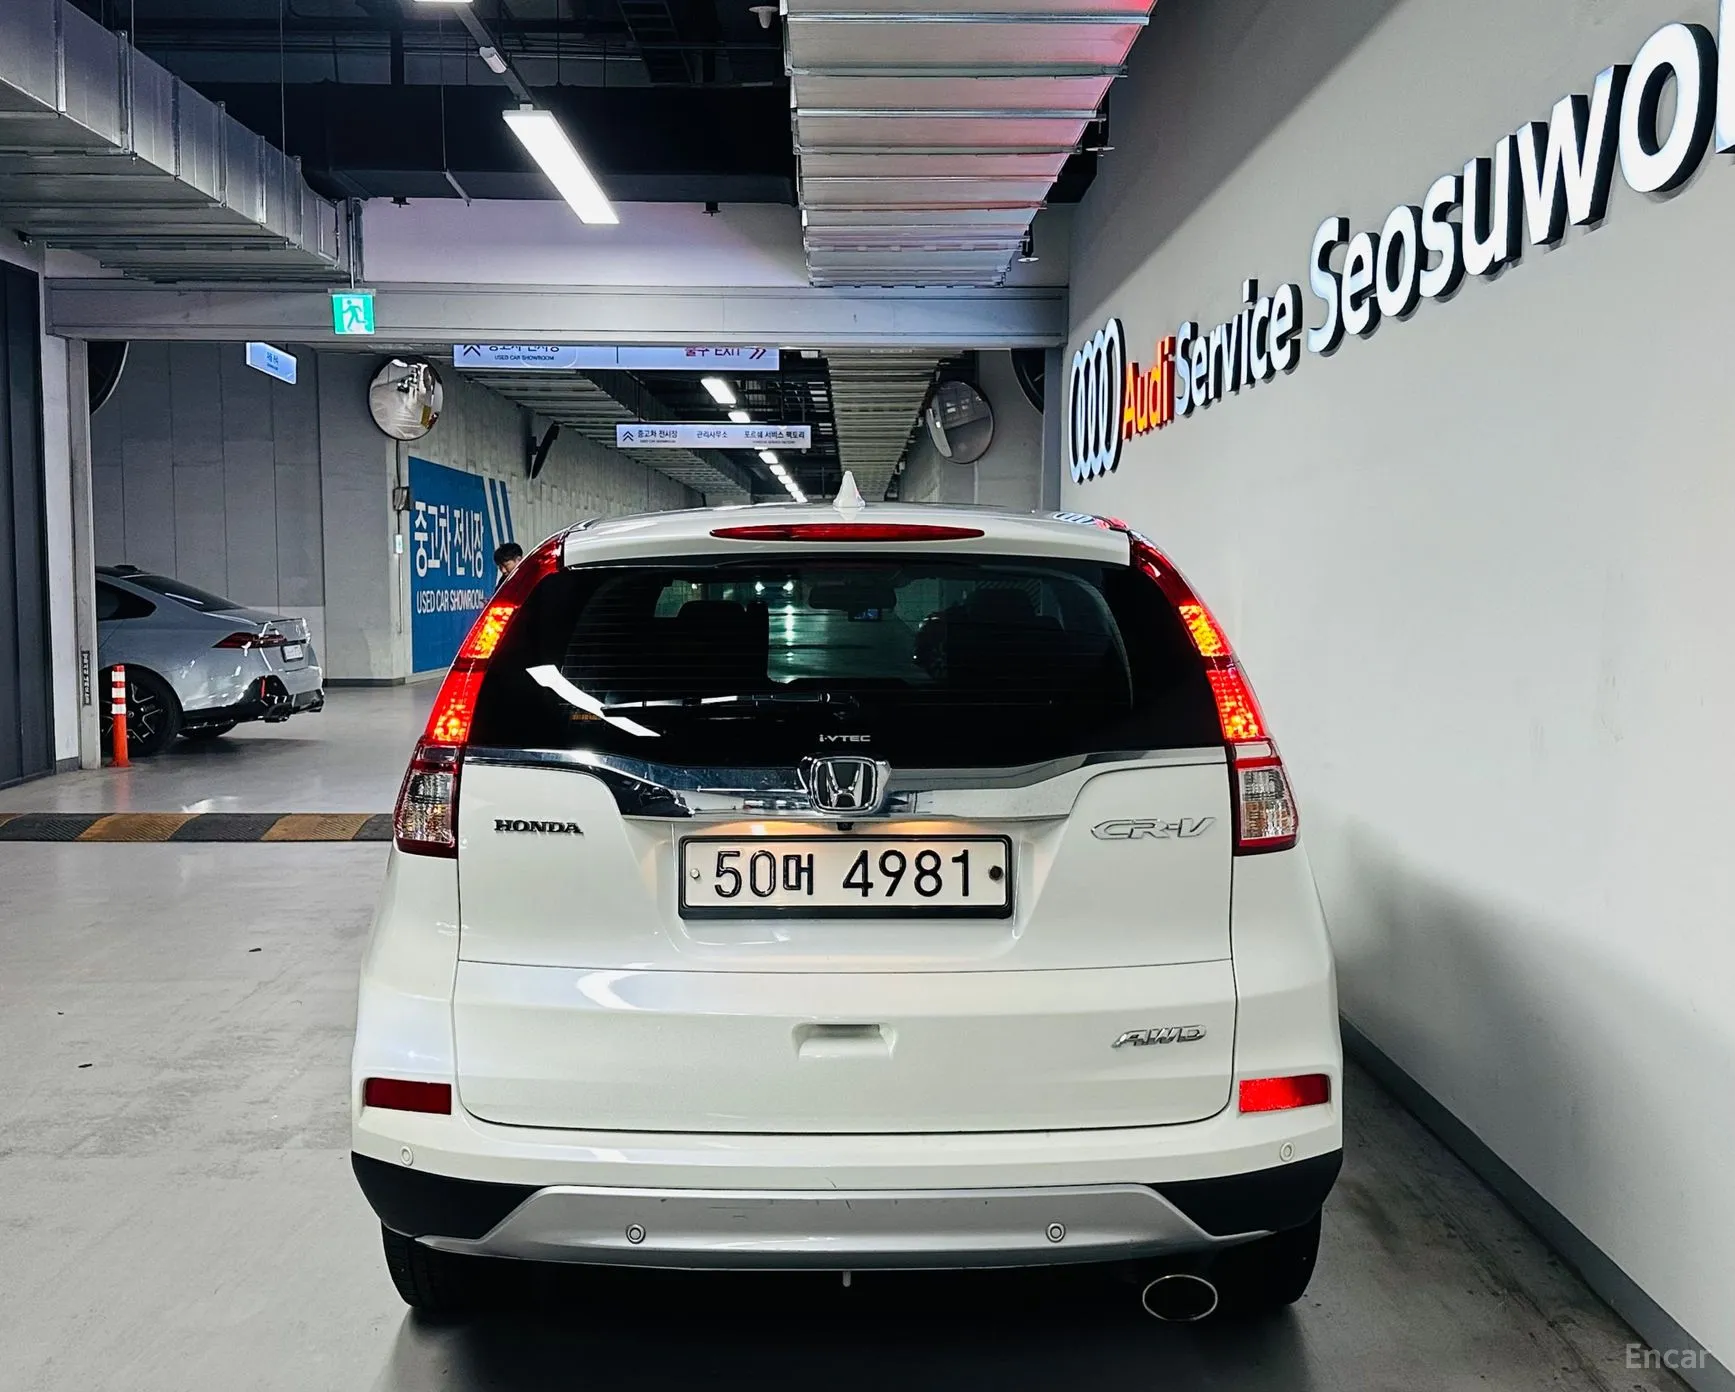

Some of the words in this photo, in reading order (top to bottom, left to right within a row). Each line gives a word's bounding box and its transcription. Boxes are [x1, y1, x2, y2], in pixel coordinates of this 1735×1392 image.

[1122, 335, 1176, 440] Audi
[1175, 278, 1302, 418] Service
[414, 501, 451, 577] 중고차
[453, 508, 484, 578] 전시장
[416, 590, 436, 614] USED
[436, 589, 449, 612] CAR
[494, 819, 584, 834] HONDA
[1091, 817, 1216, 840] CR-V
[714, 850, 814, 898] 50머
[842, 849, 970, 898] 4981
[1111, 1024, 1207, 1048] AWD
